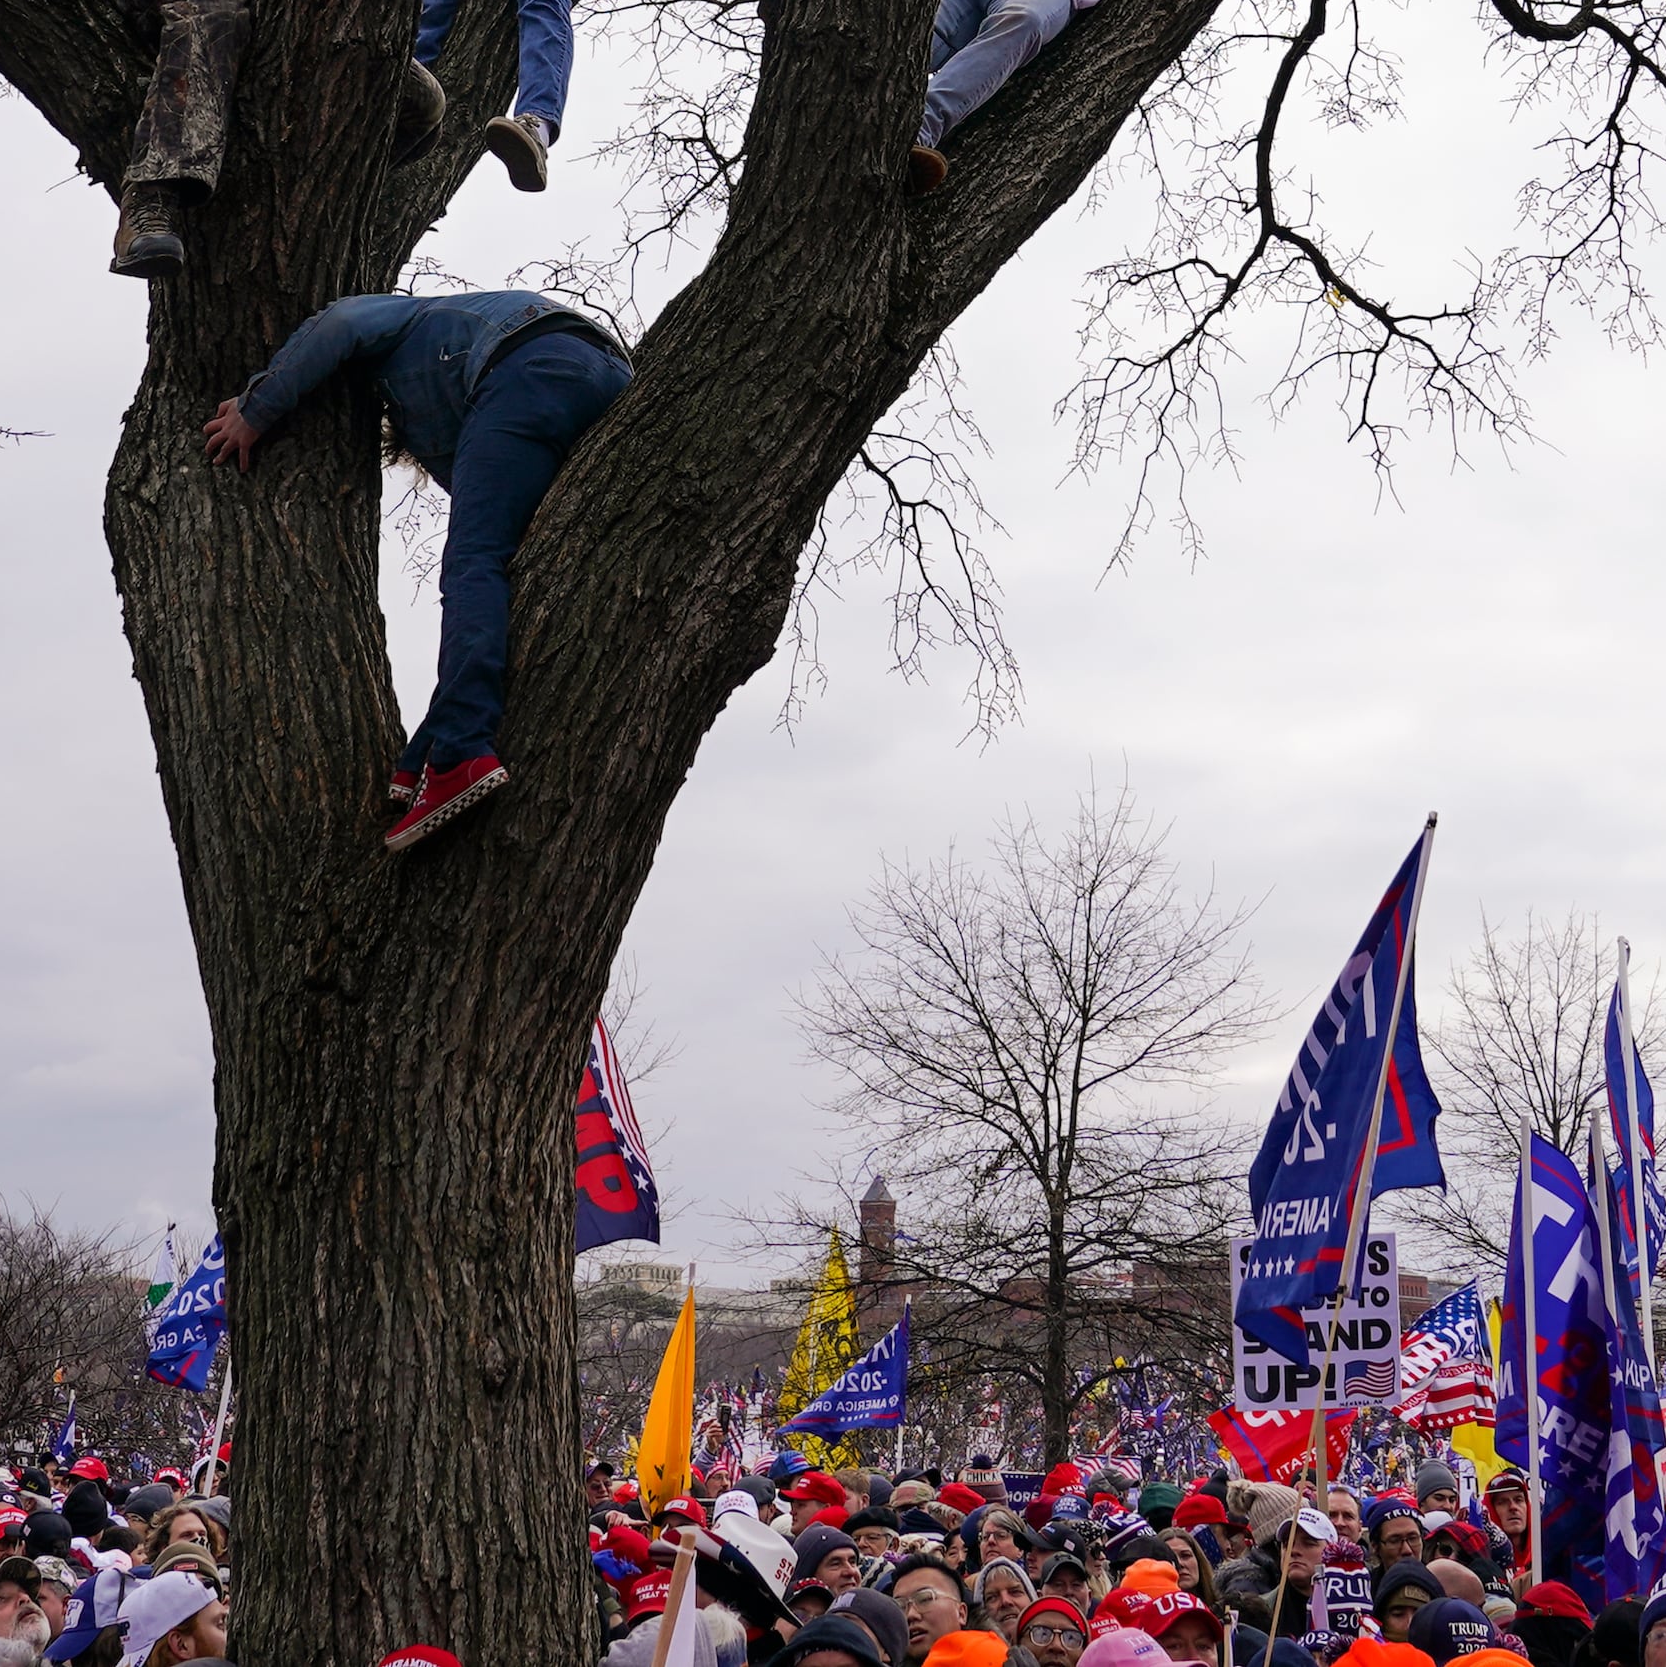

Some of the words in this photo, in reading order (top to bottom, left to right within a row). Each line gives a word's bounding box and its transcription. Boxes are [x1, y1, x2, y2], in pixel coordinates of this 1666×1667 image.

[1243, 1363, 1337, 1404] UP!
[635, 1584, 654, 1594] MAKE
[638, 1590, 661, 1602] GREAT
[1448, 1621, 1489, 1637] TRUMP
